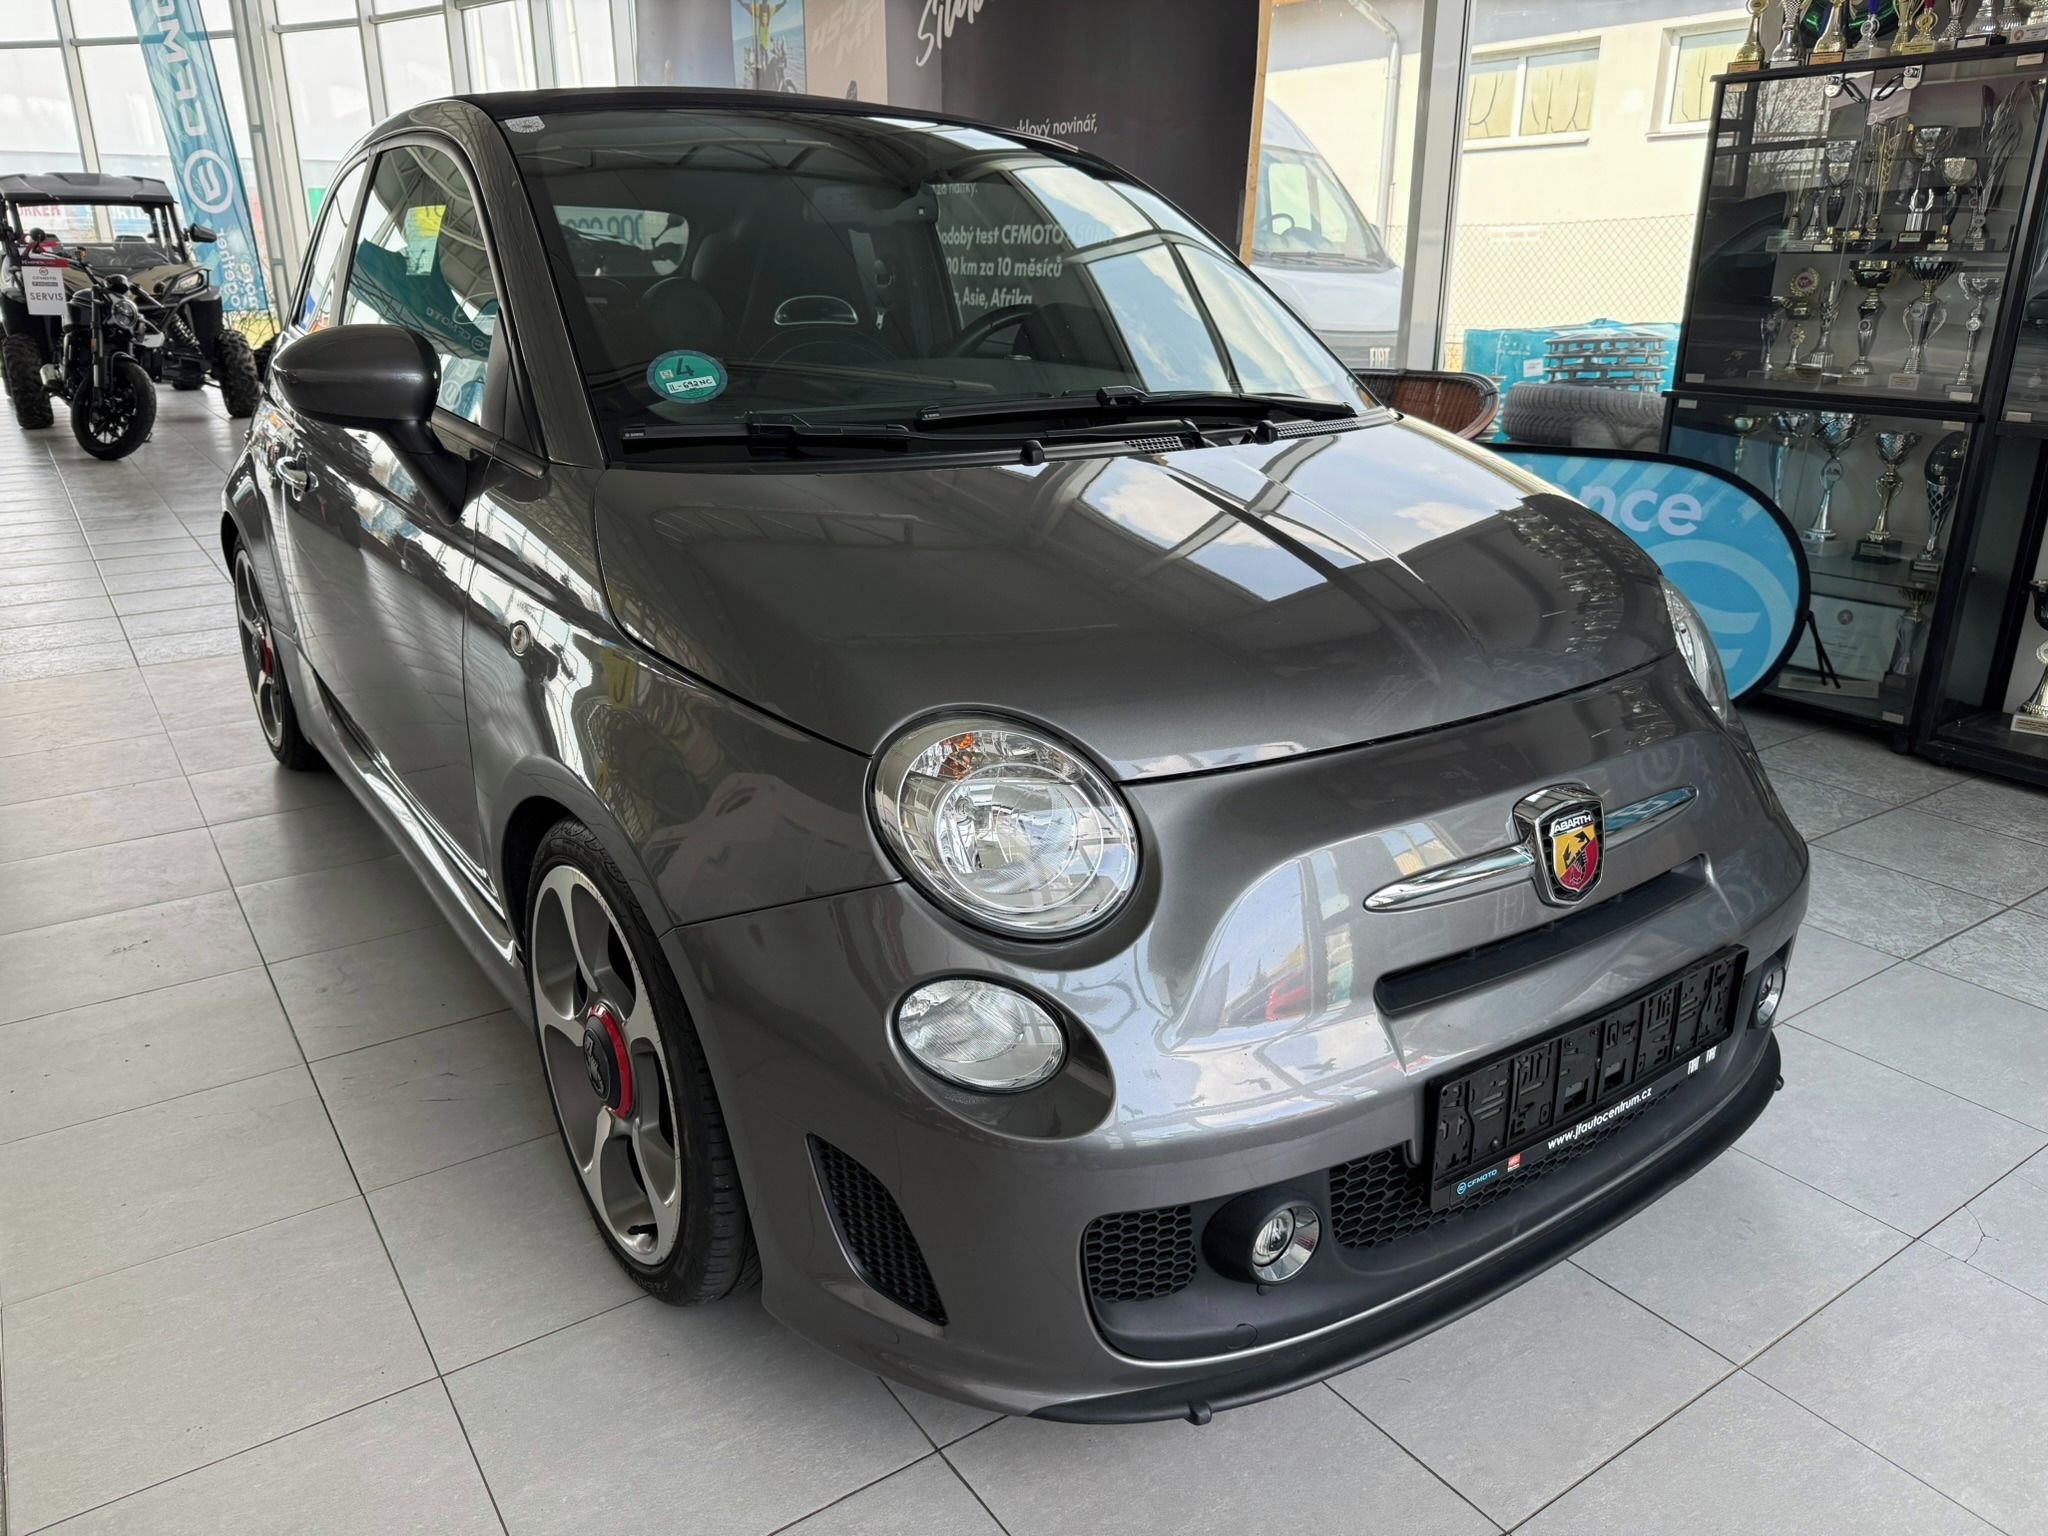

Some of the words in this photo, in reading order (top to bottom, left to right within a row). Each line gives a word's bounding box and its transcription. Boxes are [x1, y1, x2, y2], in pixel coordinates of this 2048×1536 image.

[1052, 113, 1098, 135] novinář,
[976, 226, 1000, 245] test
[1001, 223, 1064, 245] CFMOTO
[960, 256, 977, 275] km
[979, 262, 994, 276] za
[997, 257, 1011, 276] 10
[1014, 256, 1063, 277] měsíců
[30, 291, 64, 302] SERVIS
[962, 286, 988, 309] Asie,
[990, 286, 1033, 307] Afrika
[676, 357, 694, 376] 4
[1370, 347, 1391, 369] FIAT
[1554, 815, 1592, 833] ABARTH
[1547, 1087, 1653, 1150] www.jfautocentrum.cz
[1467, 1169, 1498, 1188] CFMOTO
